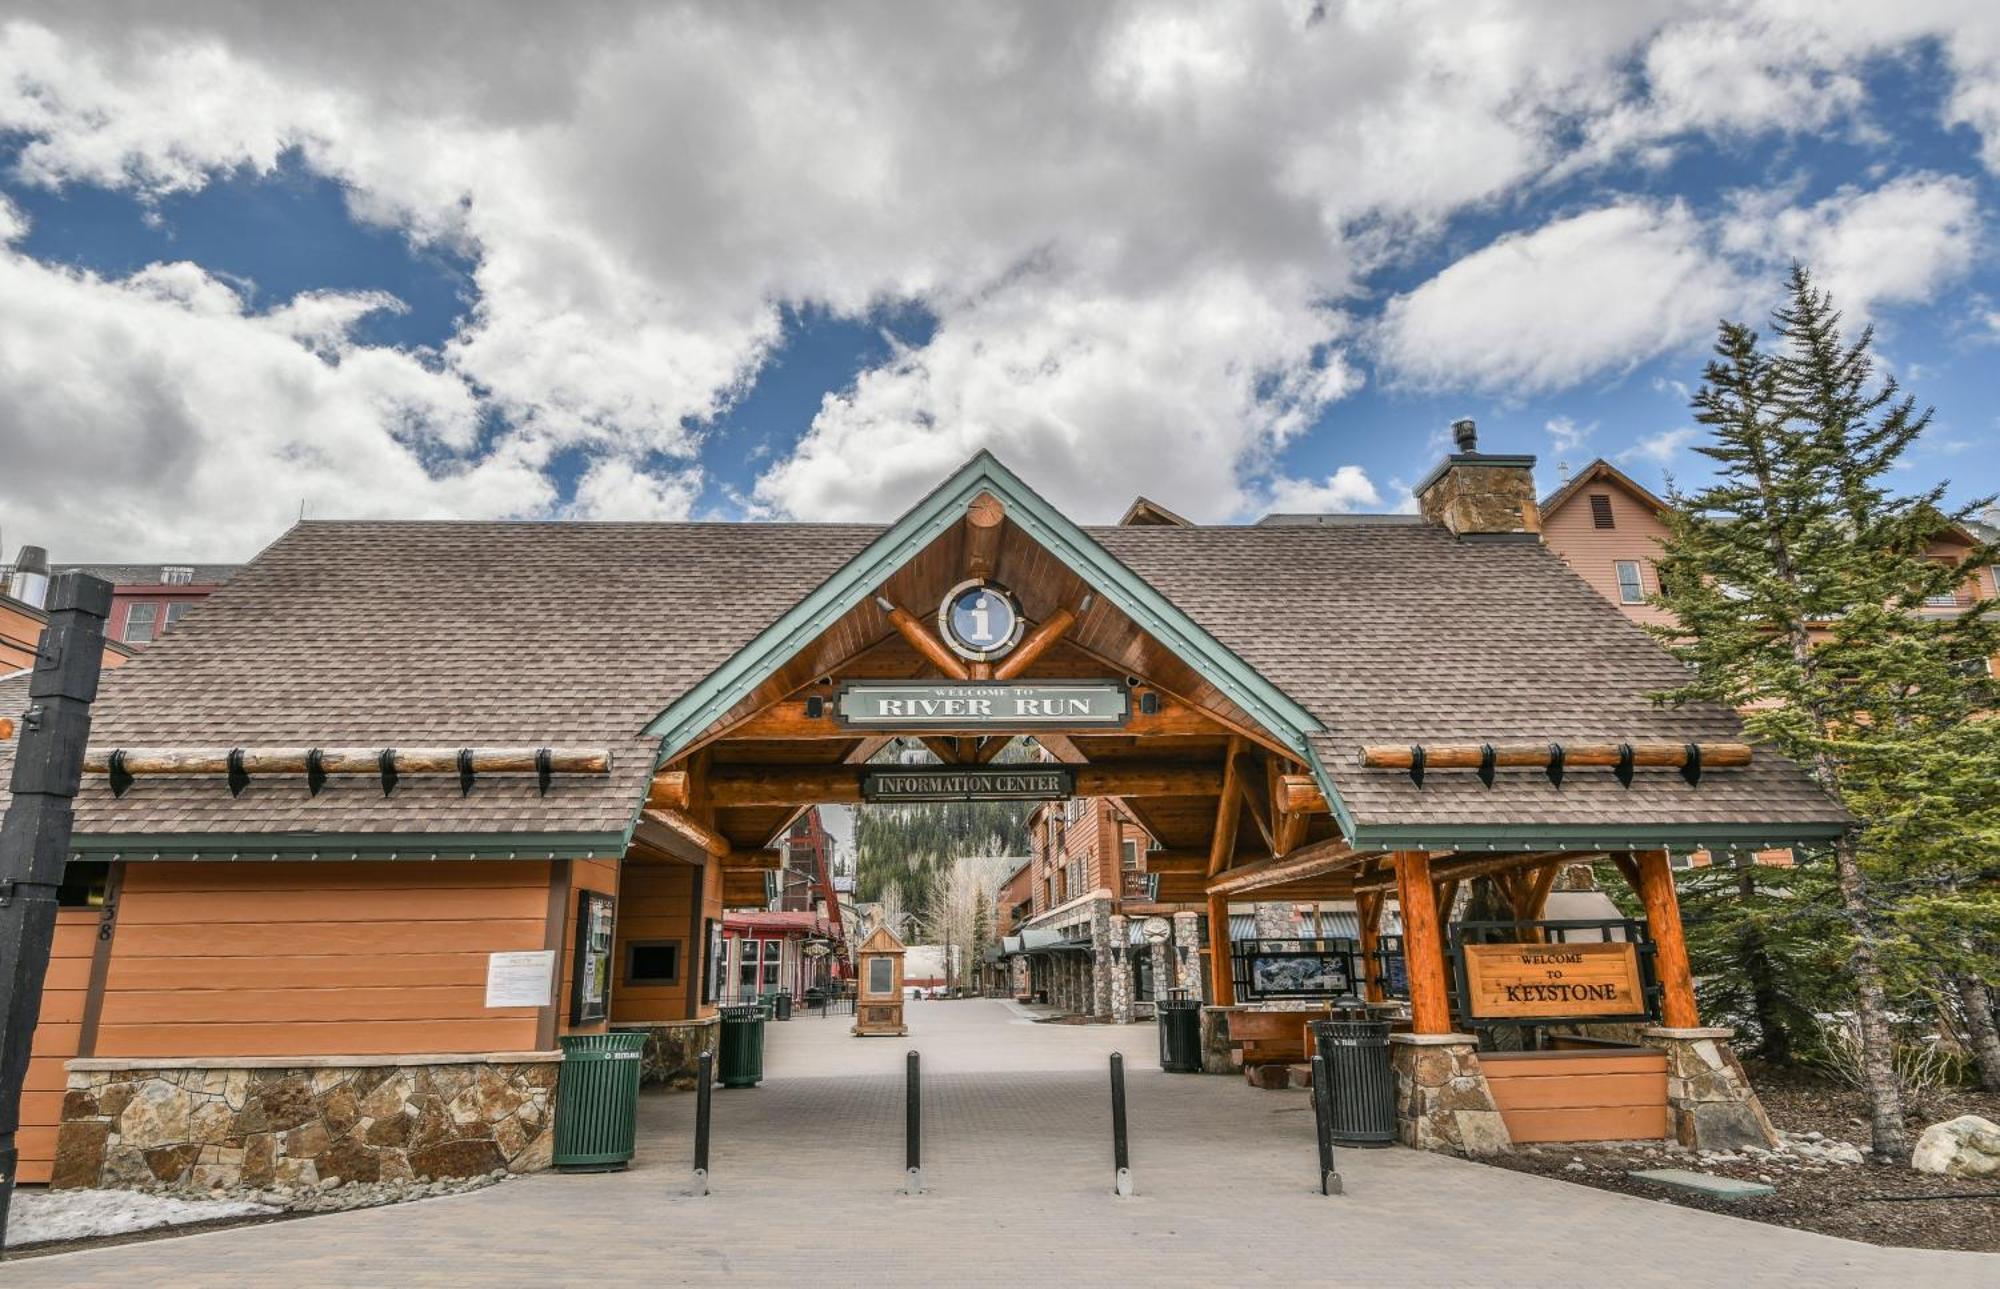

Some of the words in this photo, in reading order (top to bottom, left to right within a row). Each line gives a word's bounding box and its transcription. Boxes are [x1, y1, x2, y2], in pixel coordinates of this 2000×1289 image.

[935, 688, 1008, 697] WELCOME
[1014, 688, 1034, 697] TO
[877, 699, 993, 716] RIVER
[1014, 699, 1091, 716] RUN
[878, 776, 992, 793] INFORMATION
[996, 775, 1060, 791] CENTER
[1520, 953, 1583, 965] WELCOME
[1546, 970, 1563, 979] TO
[1506, 984, 1618, 1002] KEYSTONE
